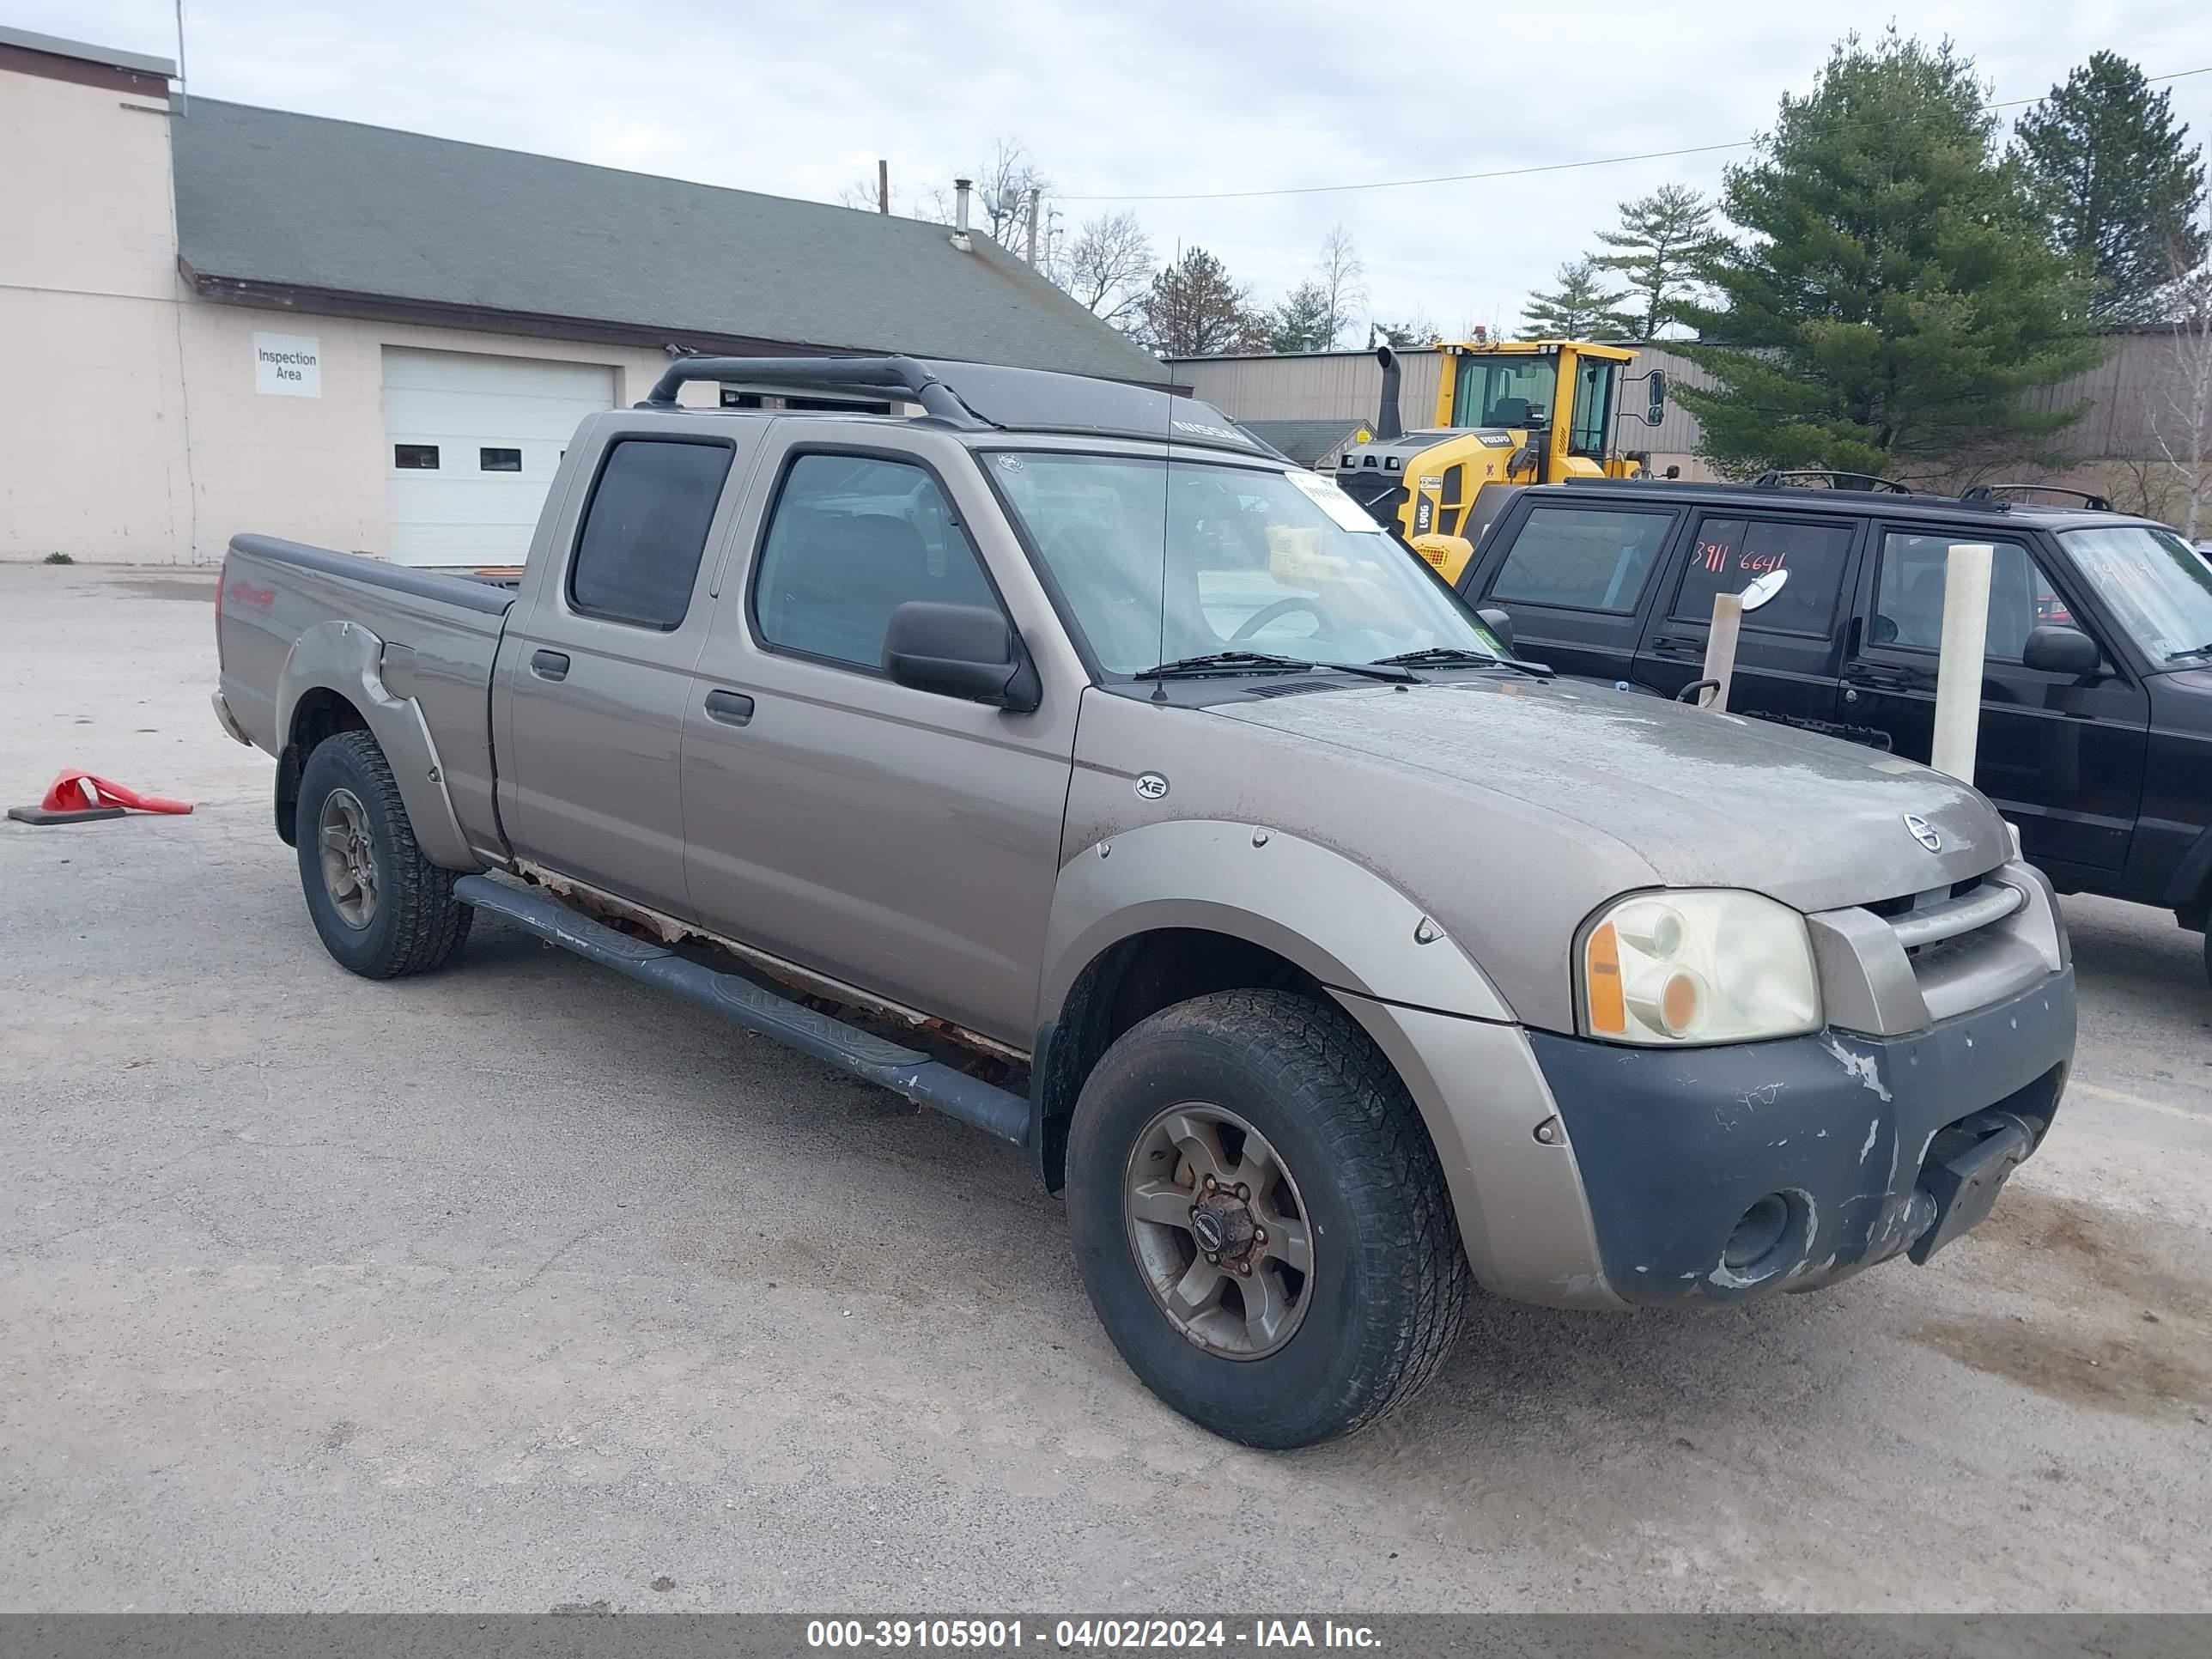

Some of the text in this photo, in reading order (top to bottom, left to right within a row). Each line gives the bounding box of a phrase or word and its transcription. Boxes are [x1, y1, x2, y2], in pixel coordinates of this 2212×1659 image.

[259, 347, 317, 366] Inspection
[276, 366, 302, 380] Area
[1479, 435, 1510, 444] VOLVO
[1419, 505, 1430, 529] L90G
[1692, 541, 1786, 573] 3911 6641
[1139, 779, 1164, 795] XE
[1197, 1220, 1218, 1245] AUTOMATIC
